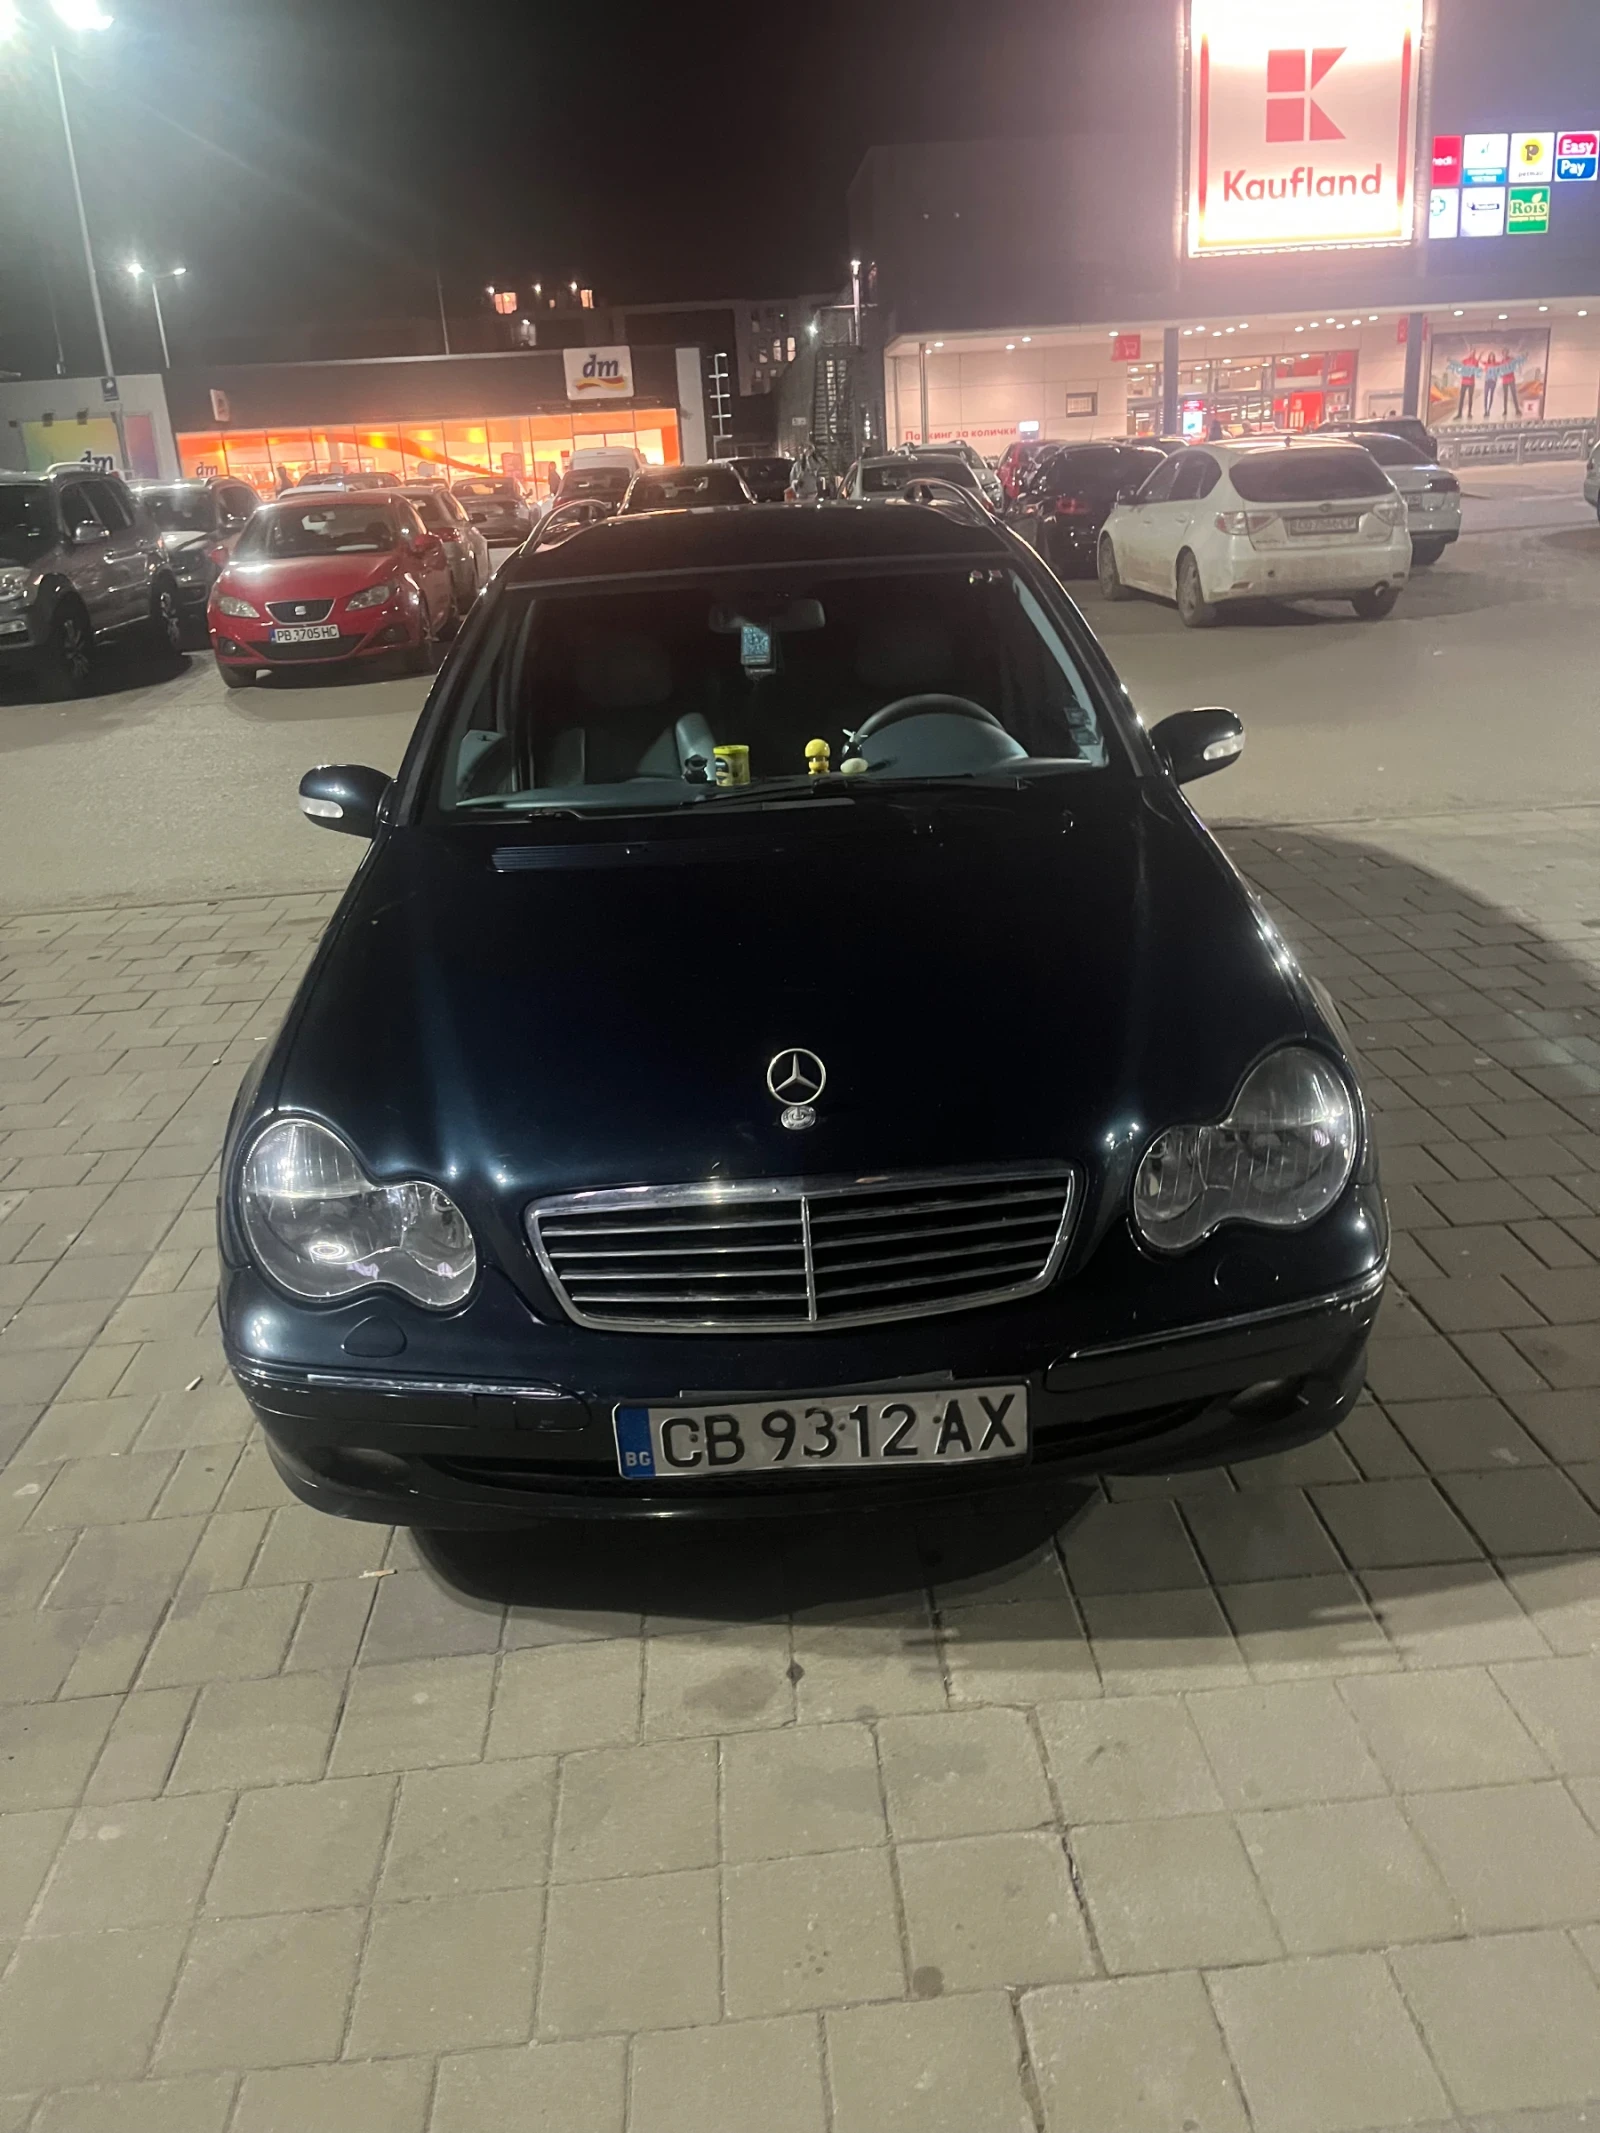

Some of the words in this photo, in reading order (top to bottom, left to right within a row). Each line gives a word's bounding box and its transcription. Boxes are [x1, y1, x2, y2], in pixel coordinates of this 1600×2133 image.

[1561, 137, 1594, 155] Easy
[1560, 159, 1586, 177] Pay
[1223, 163, 1382, 202] Kaufland
[1511, 201, 1546, 214] Rois
[582, 354, 619, 378] dm
[905, 430, 953, 441] Пакинг
[956, 430, 969, 438] за
[971, 427, 1017, 438] колички
[195, 462, 218, 477] dm
[625, 1450, 652, 1467] BG
[660, 1414, 745, 1468] CB
[761, 1403, 919, 1461] 9312
[934, 1394, 1016, 1455] AX
